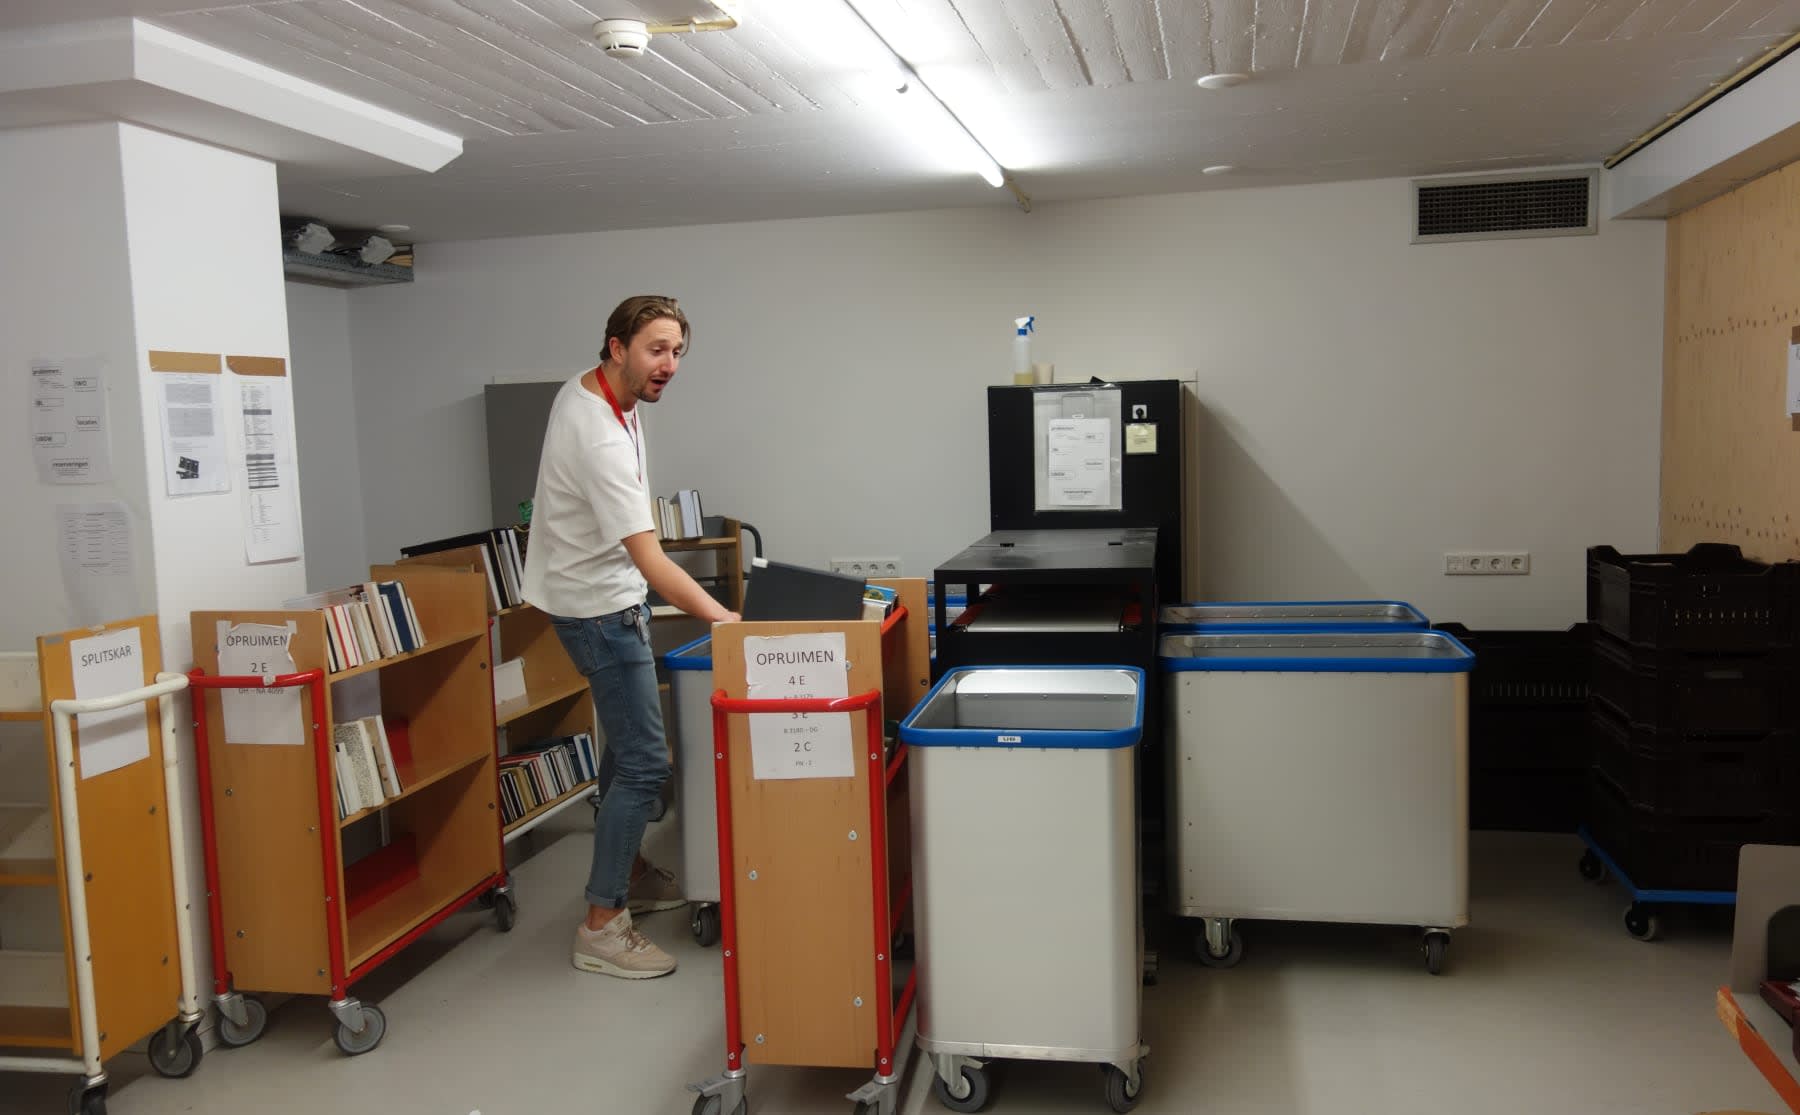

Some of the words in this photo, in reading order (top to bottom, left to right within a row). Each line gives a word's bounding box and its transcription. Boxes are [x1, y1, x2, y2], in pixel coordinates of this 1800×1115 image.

[226, 634, 288, 647] OPRUIMEN
[81, 645, 132, 667] SPLITSKAR
[756, 650, 834, 665] OPRUIMEN
[251, 662, 258, 673] 2
[261, 662, 268, 673] E
[788, 675, 796, 685] 4
[799, 675, 806, 685] E
[794, 742, 800, 752] 2
[804, 741, 812, 752] C
